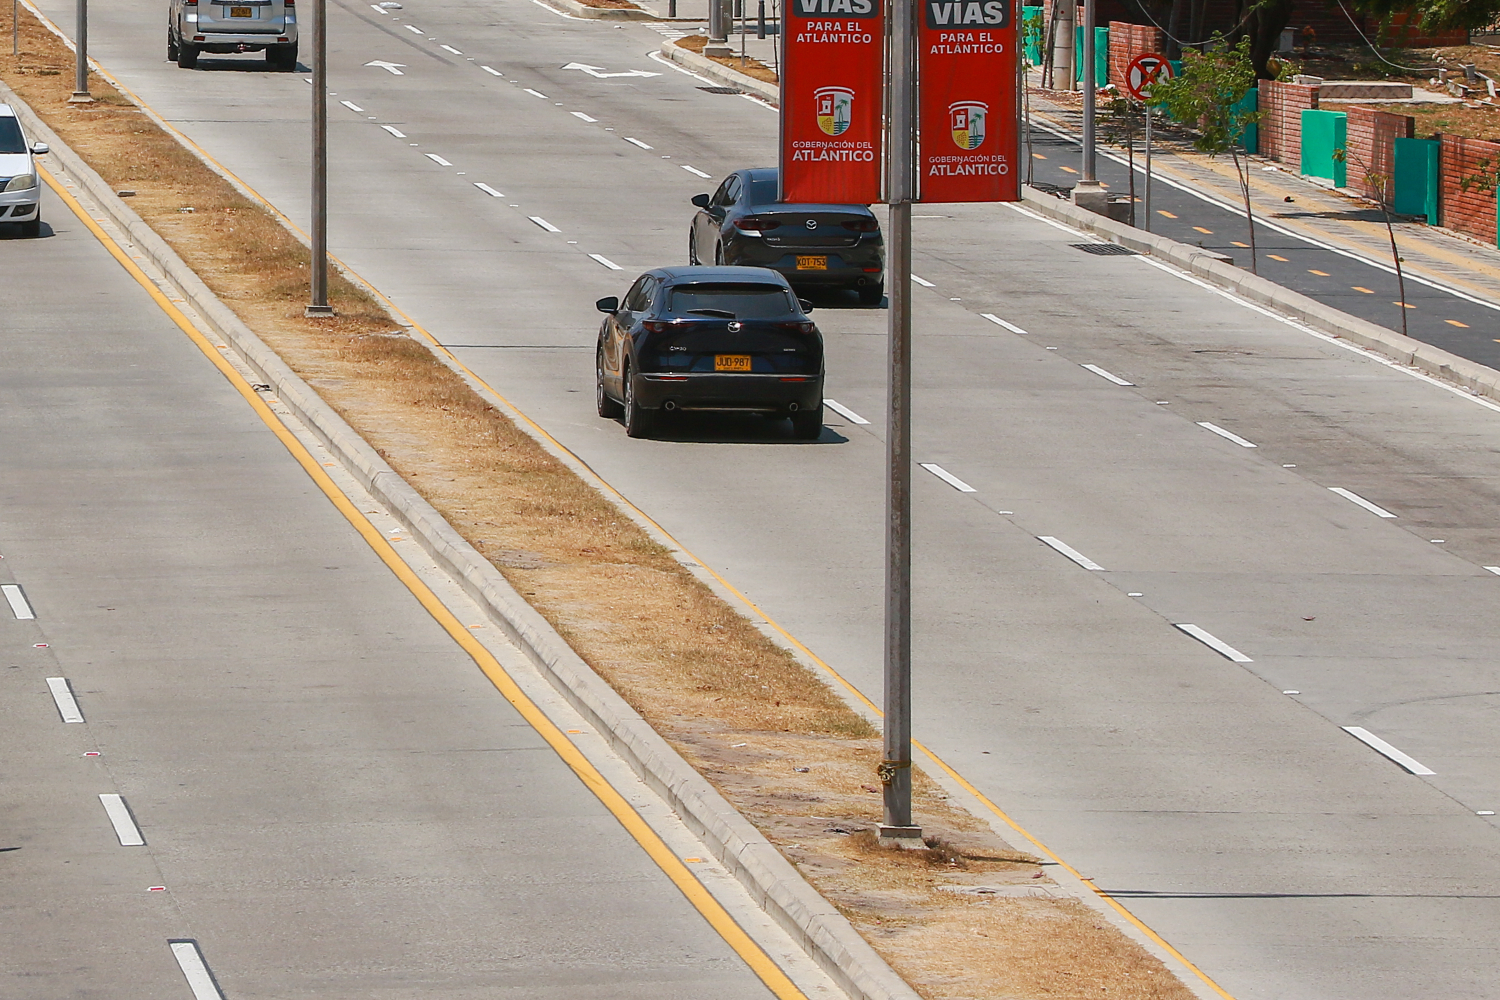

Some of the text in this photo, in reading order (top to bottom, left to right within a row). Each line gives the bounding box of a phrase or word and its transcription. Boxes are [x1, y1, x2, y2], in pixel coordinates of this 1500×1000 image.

[807, 21, 862, 31] PARA EL
[796, 32, 872, 43] ATLÁNTICO
[940, 33, 993, 42] PARA EL
[930, 42, 1003, 54] ATLÁNTICO
[792, 140, 873, 149] GOBERNACIÓN DEL
[792, 147, 874, 162] ATLÁNTICO
[929, 154, 990, 163] GOBERNACIÓN
[929, 162, 1009, 176] ATLÁNTICO
